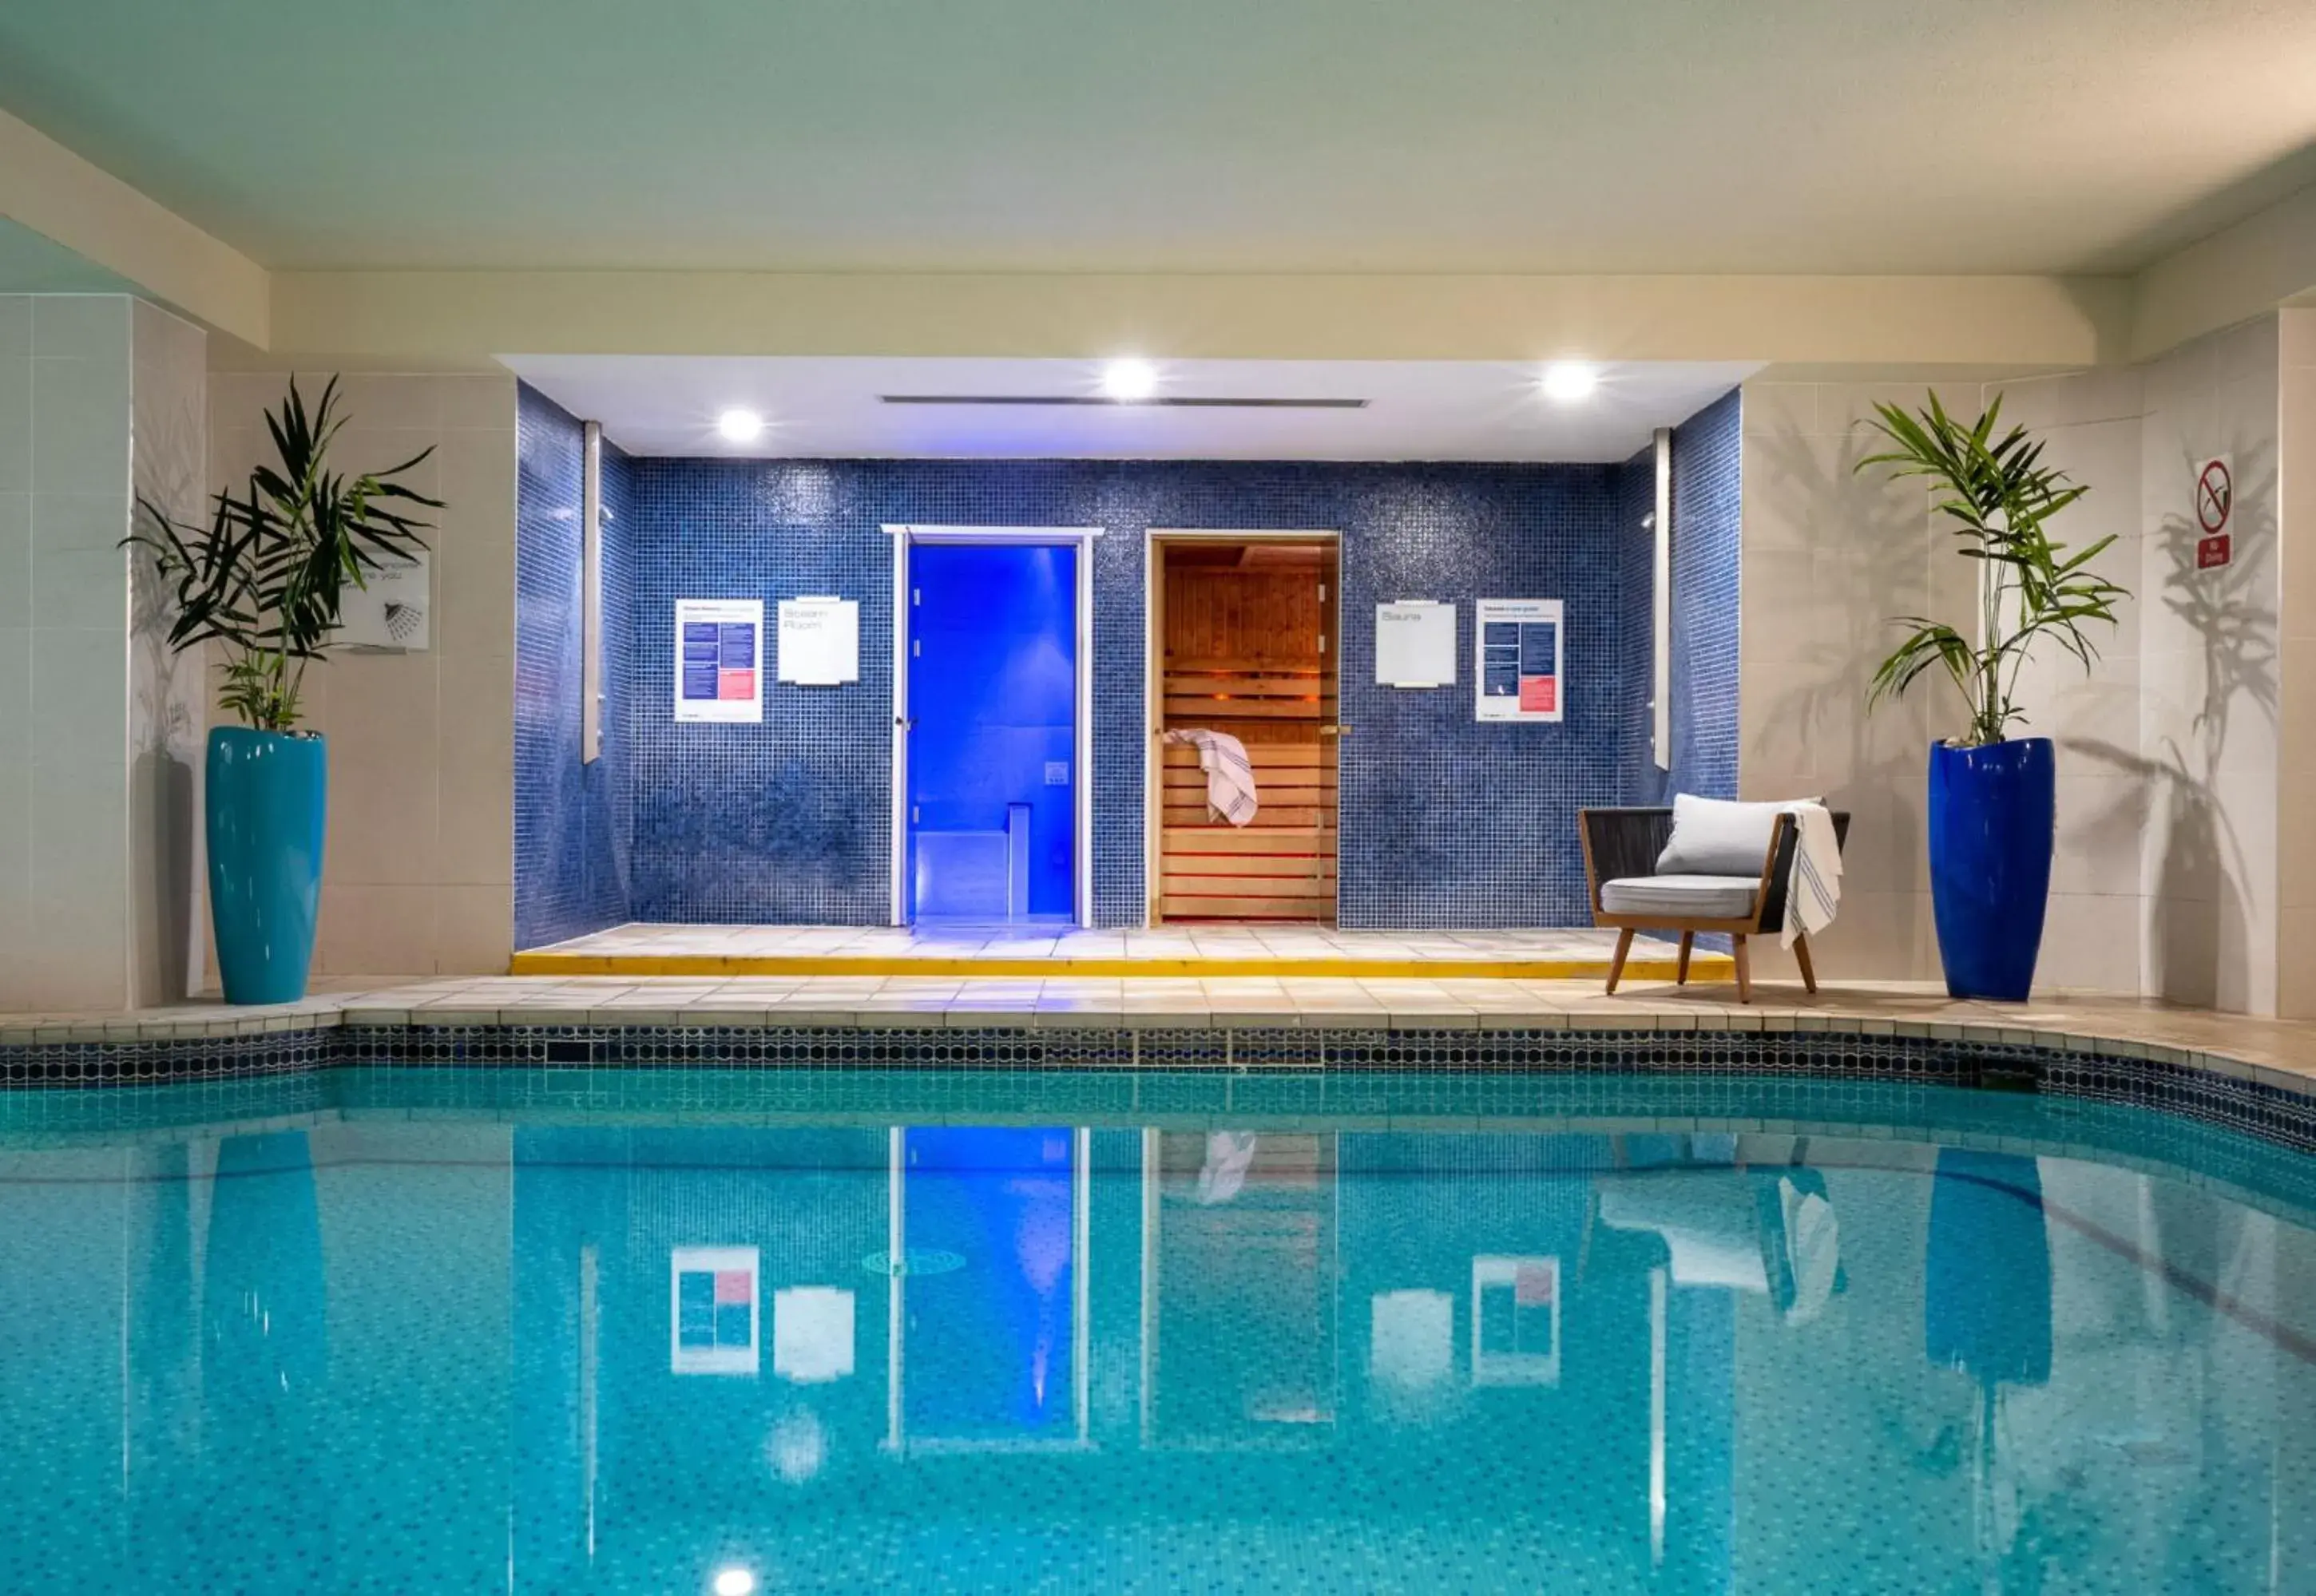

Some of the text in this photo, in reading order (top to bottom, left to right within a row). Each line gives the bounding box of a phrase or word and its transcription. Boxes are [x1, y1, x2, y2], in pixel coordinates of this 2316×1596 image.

[783, 608, 828, 618] Steam
[1382, 611, 1422, 621] Sauna
[783, 620, 823, 630] Room
